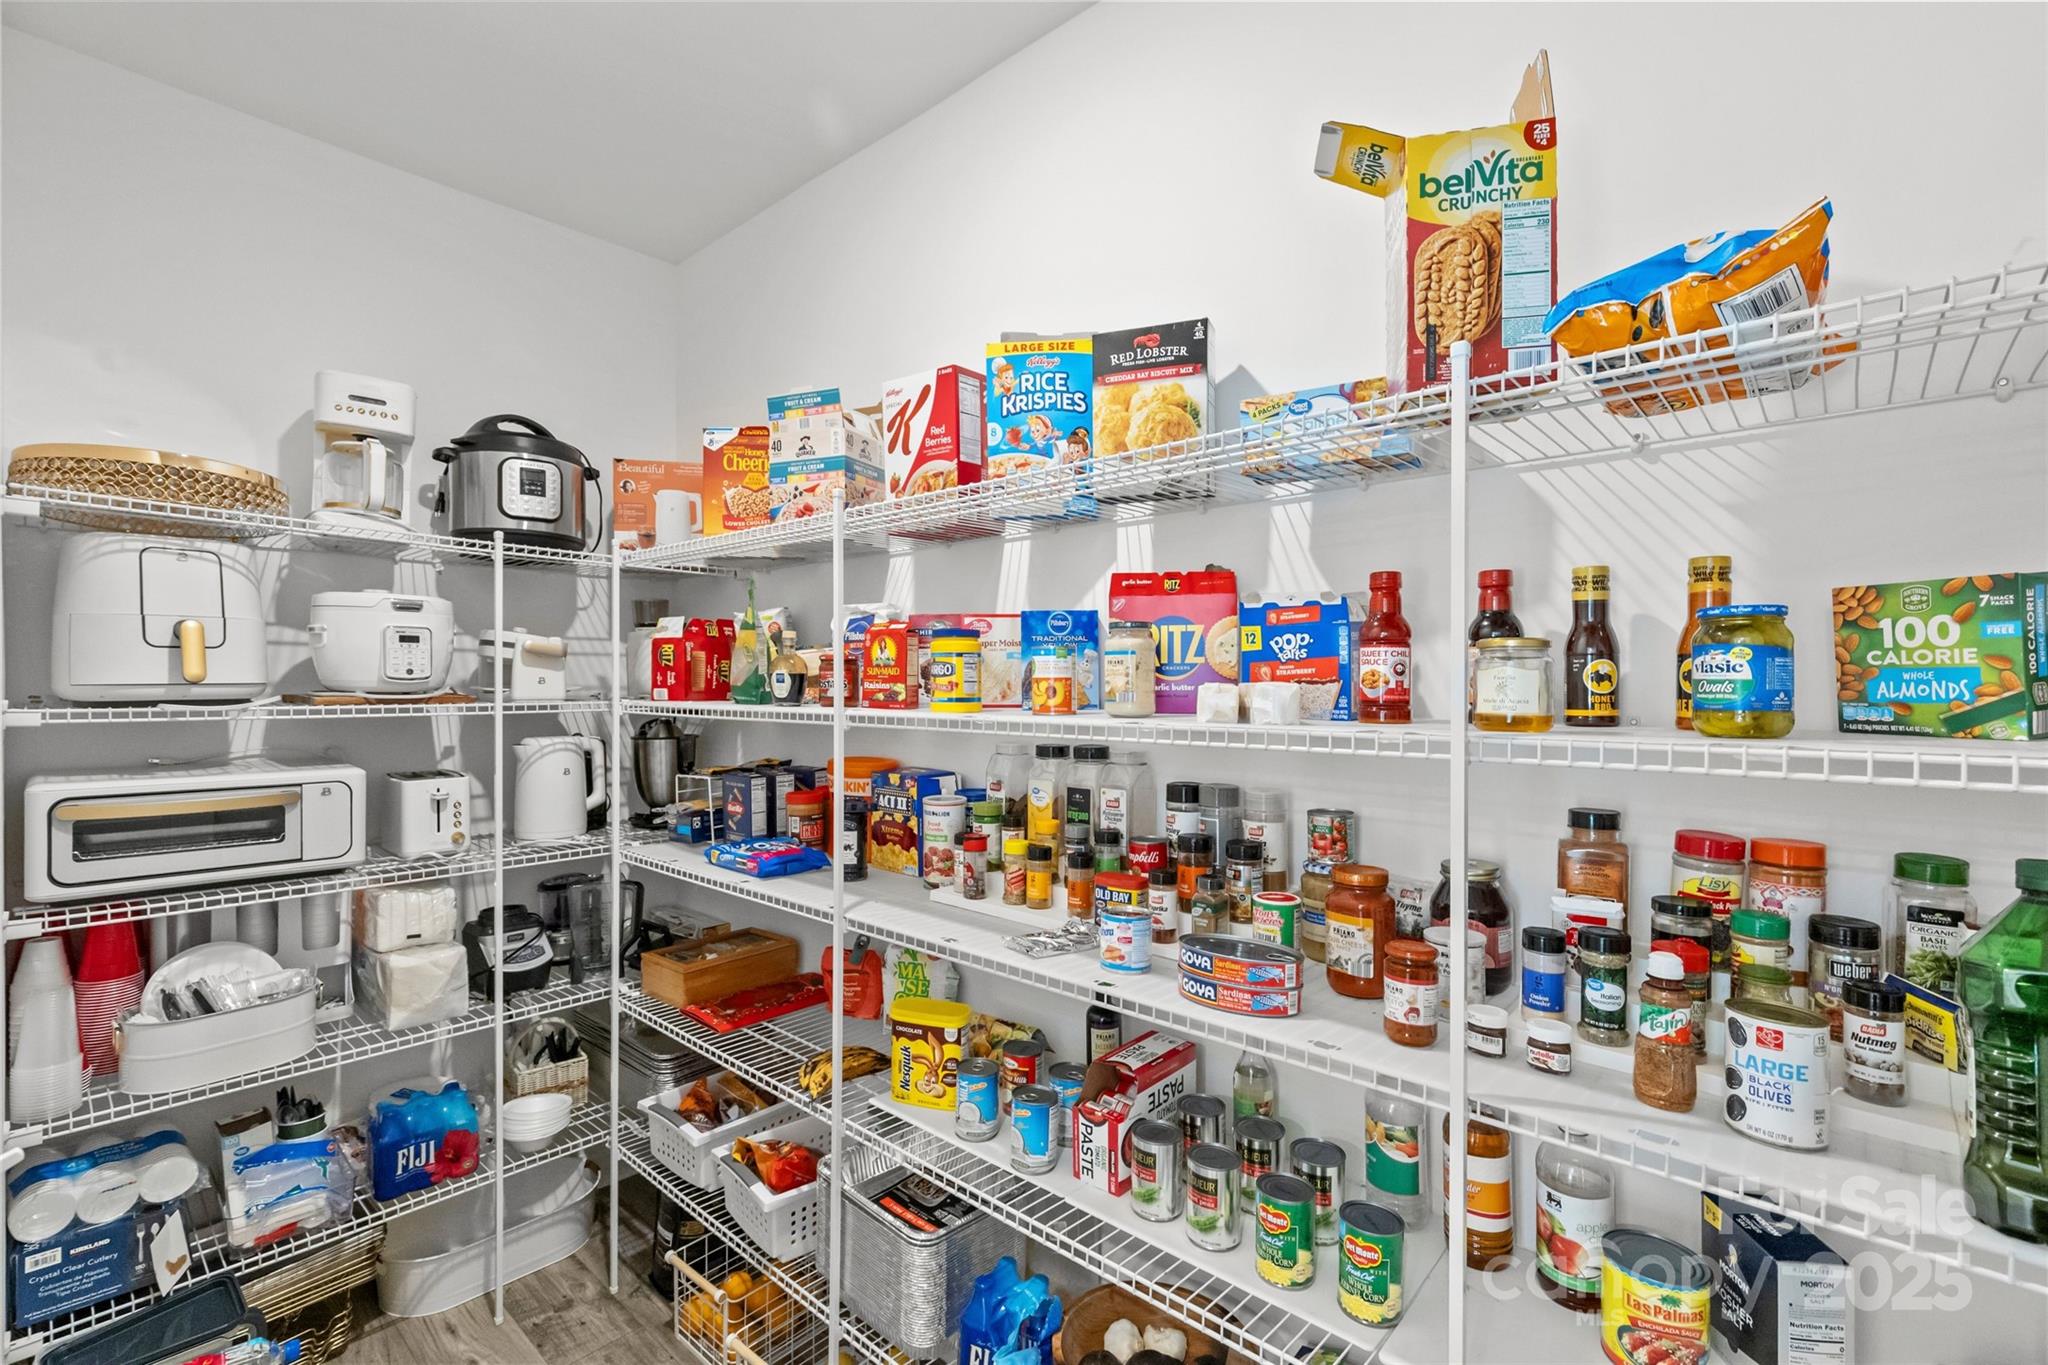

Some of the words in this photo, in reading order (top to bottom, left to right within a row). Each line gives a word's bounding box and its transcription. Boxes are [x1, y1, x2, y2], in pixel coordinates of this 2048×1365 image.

[1533, 123, 1550, 133] 25
[1360, 143, 1388, 186] belVita
[1420, 149, 1543, 198] belVita
[1438, 186, 1523, 212] CRUNCHY
[1004, 343, 1044, 353] LARGE
[1048, 341, 1076, 351] SIZE
[1110, 352, 1135, 366] RED
[1136, 346, 1189, 360] LOBSTER
[1021, 372, 1068, 393] RICE
[1105, 374, 1136, 383] CHEDDAR
[784, 398, 799, 406] FRUIT
[804, 396, 822, 404] CREAM
[1002, 392, 1088, 416] KRISPIES
[1258, 402, 1282, 416] PACKS
[887, 384, 931, 455] K
[931, 425, 945, 436] Red
[771, 440, 782, 452] 40
[925, 435, 952, 447] Berries
[796, 449, 816, 458] QUAKER
[618, 463, 665, 475] Beautiful
[1122, 579, 1136, 587] garlic
[1164, 579, 1181, 590] RITZ
[1904, 603, 1928, 611] GROVE
[1979, 594, 1989, 607] 7
[2026, 588, 2036, 650] CALORIE
[1879, 614, 1961, 649] 100
[1986, 626, 2015, 634] FREE
[1151, 624, 1206, 667] RITZ
[1245, 633, 1256, 644] 12
[660, 644, 674, 667] RITZ
[1278, 648, 1308, 662] tarts
[1866, 648, 1978, 666] CALORIE
[719, 659, 730, 682] RITZ
[2029, 653, 2037, 674] 100
[1276, 668, 1316, 676] STRAWBERRY
[1903, 671, 1935, 680] WHOLE
[1155, 683, 1170, 691] arlic
[1172, 683, 1195, 691] butter
[1698, 680, 1735, 693] Ovals
[1876, 679, 1969, 701] ALMONDS
[1588, 695, 1615, 703] HONEY
[879, 796, 895, 810] ACT
[896, 798, 907, 810] II
[881, 825, 904, 835] Xtreme
[1699, 877, 1731, 892] Lisy
[1096, 889, 1110, 899] OLD
[1112, 891, 1130, 903] BAY
[1395, 901, 1422, 913] Thyme
[1911, 925, 1958, 937] ORGANIC
[1920, 935, 1949, 946] BASIL
[1181, 948, 1212, 970] GOYA
[1833, 960, 1873, 980] weber
[1182, 977, 1216, 1000] GOYA
[1218, 987, 1251, 999] Sardinas
[1529, 998, 1551, 1007] Powder
[1530, 993, 1549, 1001] Onion
[896, 1025, 923, 1035] CHOCOLATE
[1862, 1026, 1885, 1034] BADIA
[1851, 1032, 1897, 1050] Nutmeg
[1115, 1044, 1147, 1060] PASTE
[1529, 1049, 1555, 1060] nutella
[900, 1045, 911, 1092] Nesquik
[1735, 1049, 1809, 1082] LARGE
[1748, 1074, 1791, 1092] BLACK
[1148, 1074, 1185, 1113] PASTE
[1748, 1085, 1792, 1105] OLIVES
[1767, 1130, 1774, 1138] OZ
[1080, 1122, 1094, 1179] PASTE
[395, 1140, 436, 1176] FIJI
[1259, 1207, 1267, 1217] Del
[1267, 1213, 1288, 1226] Monte
[1576, 1222, 1609, 1234] apple
[1750, 1213, 1782, 1237] MORTON
[69, 1238, 111, 1254] KIRKLAND
[1261, 1242, 1282, 1258] WHOLE
[1345, 1240, 1355, 1251] Del
[1355, 1246, 1379, 1260] Monte
[28, 1268, 60, 1284] Crystal
[62, 1262, 85, 1274] Clear
[87, 1252, 119, 1266] Cutlery
[1274, 1255, 1294, 1267] CORN
[1360, 1271, 1376, 1281] Cut
[1719, 1259, 1750, 1294] MORTON
[37, 1283, 81, 1298] Transparente
[39, 1278, 72, 1292] Cubiertos
[56, 1289, 71, 1298] Tipo
[73, 1282, 94, 1292] Cristal
[1349, 1275, 1373, 1294] WHOLE
[1800, 1281, 1835, 1289] MORTON
[1363, 1290, 1385, 1303] CORN
[1626, 1293, 1651, 1316] Las
[1653, 1305, 1704, 1324] Palmas
[1715, 1281, 1753, 1328] KOSHER
[1721, 1302, 1743, 1331] SALT
[1637, 1320, 1680, 1335] ENCHILADA
[1681, 1328, 1701, 1338] SAUCE
[1789, 1322, 1822, 1331] Nutrition
[1789, 1344, 1814, 1352] Calories
